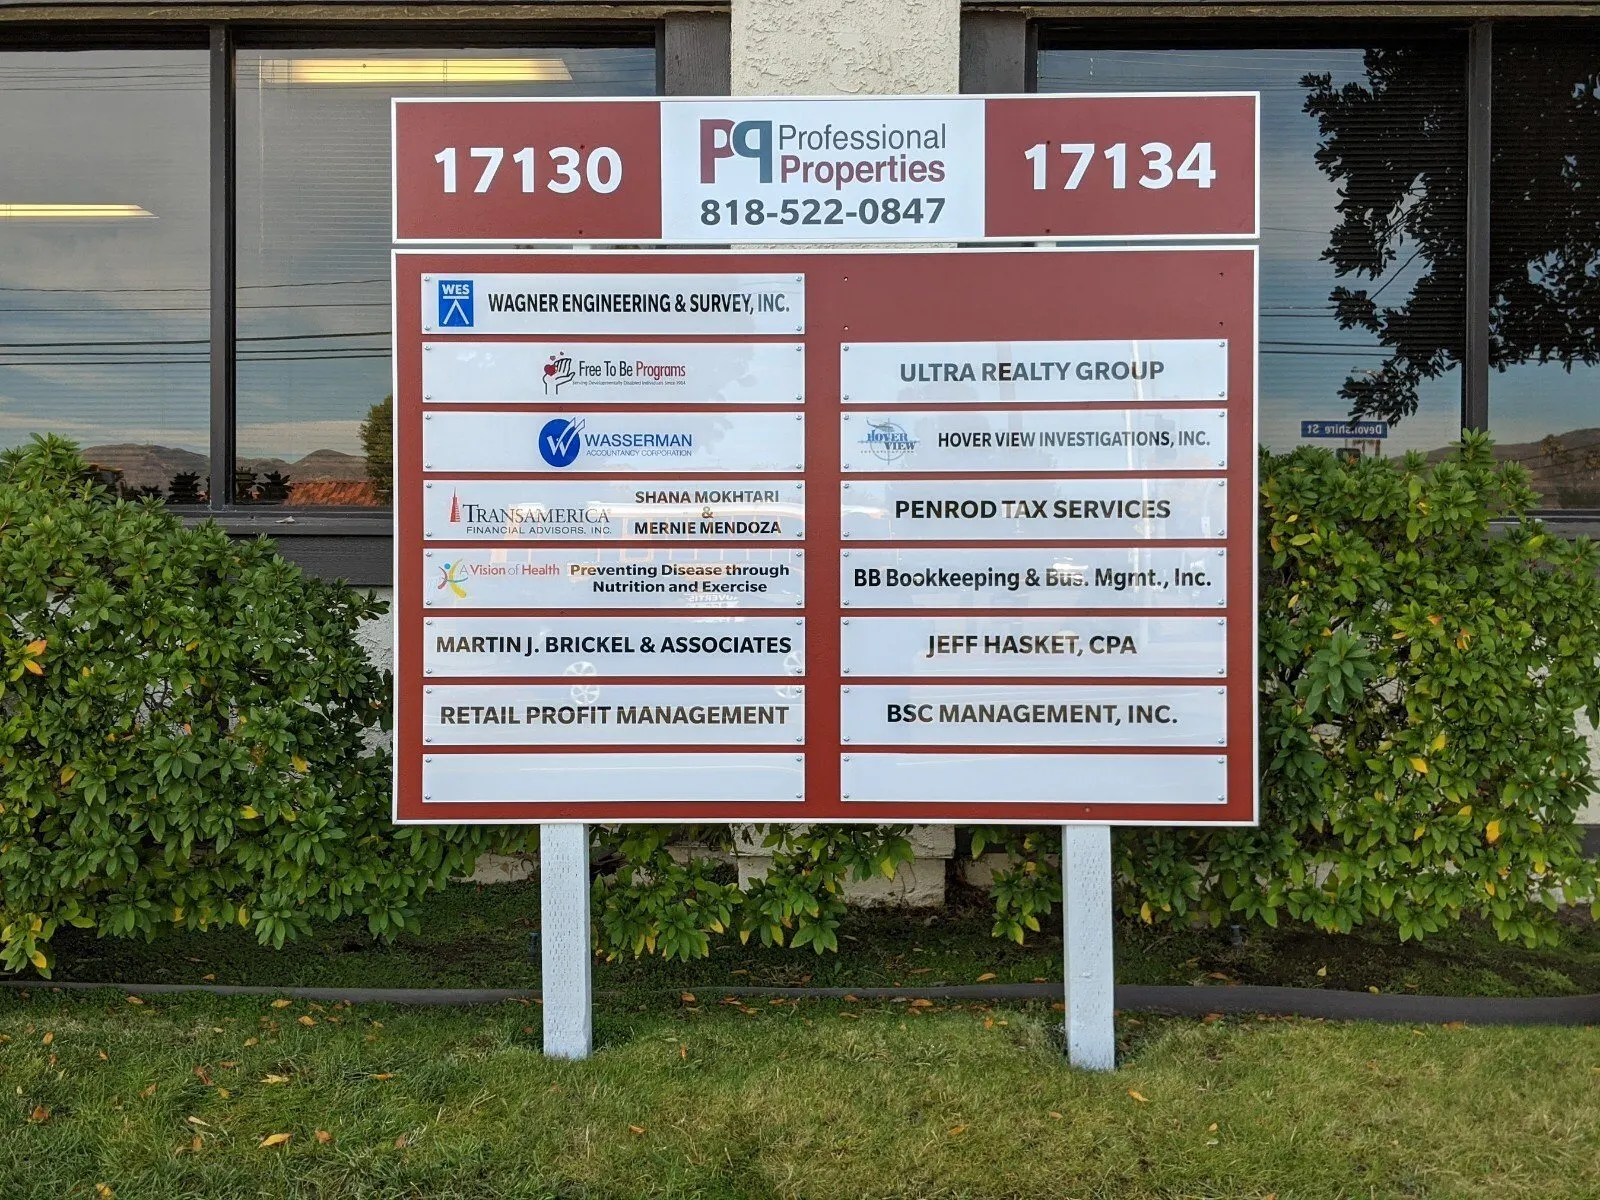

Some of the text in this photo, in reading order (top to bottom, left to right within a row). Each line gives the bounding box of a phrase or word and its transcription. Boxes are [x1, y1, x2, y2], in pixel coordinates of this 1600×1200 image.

[779, 123, 946, 150] Professional
[434, 147, 623, 194] 17130
[781, 153, 945, 190] Properties
[1024, 142, 1217, 190] 17134
[700, 198, 946, 226] 818-522-0847
[441, 284, 470, 295] WES
[488, 293, 790, 315] WAGNER ENGINEERING & SURVEY, INC.
[579, 361, 686, 380] Free To Be Programs
[900, 361, 1165, 382] ULTRA REALTY GROUP
[585, 434, 692, 447] WASSERMAN
[867, 429, 908, 441] HOVER
[938, 431, 1211, 449] HOVER VIEW INVESTIGATIONS, INC.
[884, 441, 916, 450] VIEW
[635, 490, 779, 503] SHANA MOKHTARI
[701, 507, 713, 518] &
[895, 500, 1171, 518] PENROD TAX SERVICES
[466, 526, 524, 534] FINANCIAL
[591, 526, 612, 534] INC.
[634, 521, 782, 535] MERNIE MENDOZA
[460, 563, 560, 575] A Vision of Health
[570, 564, 790, 578] Preventing Disease through
[593, 580, 768, 593] Nutrition and Exercise
[854, 567, 1212, 591] BB Bookkeeping & Bus. Mgmt., Inc.
[436, 636, 792, 657] MARTIN J. BRICKEL & ASSOCIATES
[926, 635, 1137, 658] JEFF HASKET, CPA
[440, 706, 790, 725] RETAIL PROFIT MANAGEMENT
[887, 704, 1178, 726] BSC MANAGEMENT, INC.
